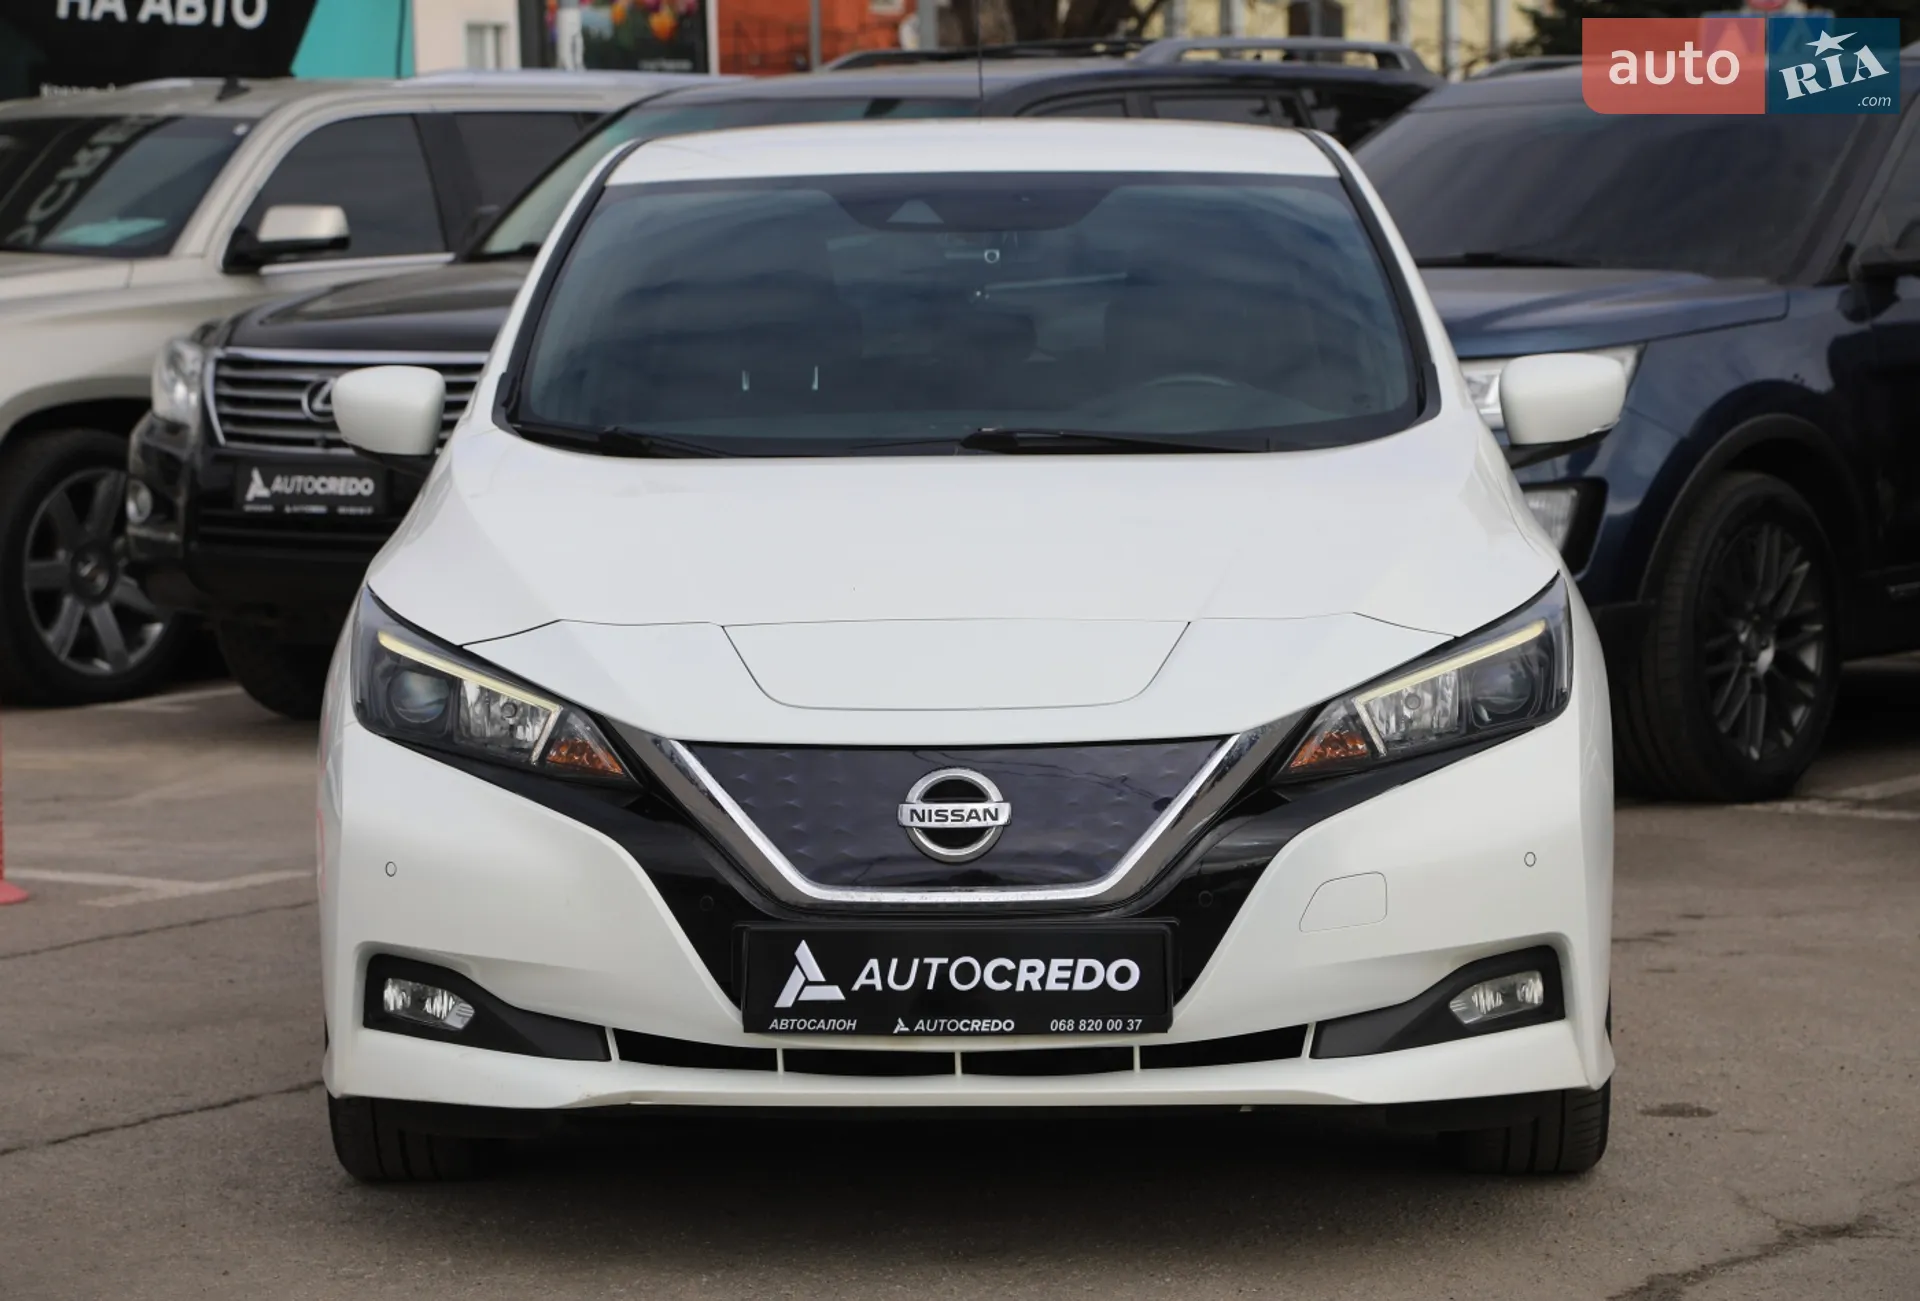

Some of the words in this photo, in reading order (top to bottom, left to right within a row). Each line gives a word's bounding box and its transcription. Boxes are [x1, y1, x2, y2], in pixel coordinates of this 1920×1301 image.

[271, 475, 375, 496] AUTOCREDO
[909, 807, 999, 823] NISSAN
[851, 956, 1141, 991] AUTOCREDO
[769, 1018, 857, 1031] АВТОСАЛОН
[914, 1018, 1015, 1032] AUTOCREDO
[1050, 1019, 1075, 1031] 068
[1078, 1019, 1103, 1031] 820
[1106, 1019, 1123, 1031] 00
[1126, 1019, 1143, 1031] 37
